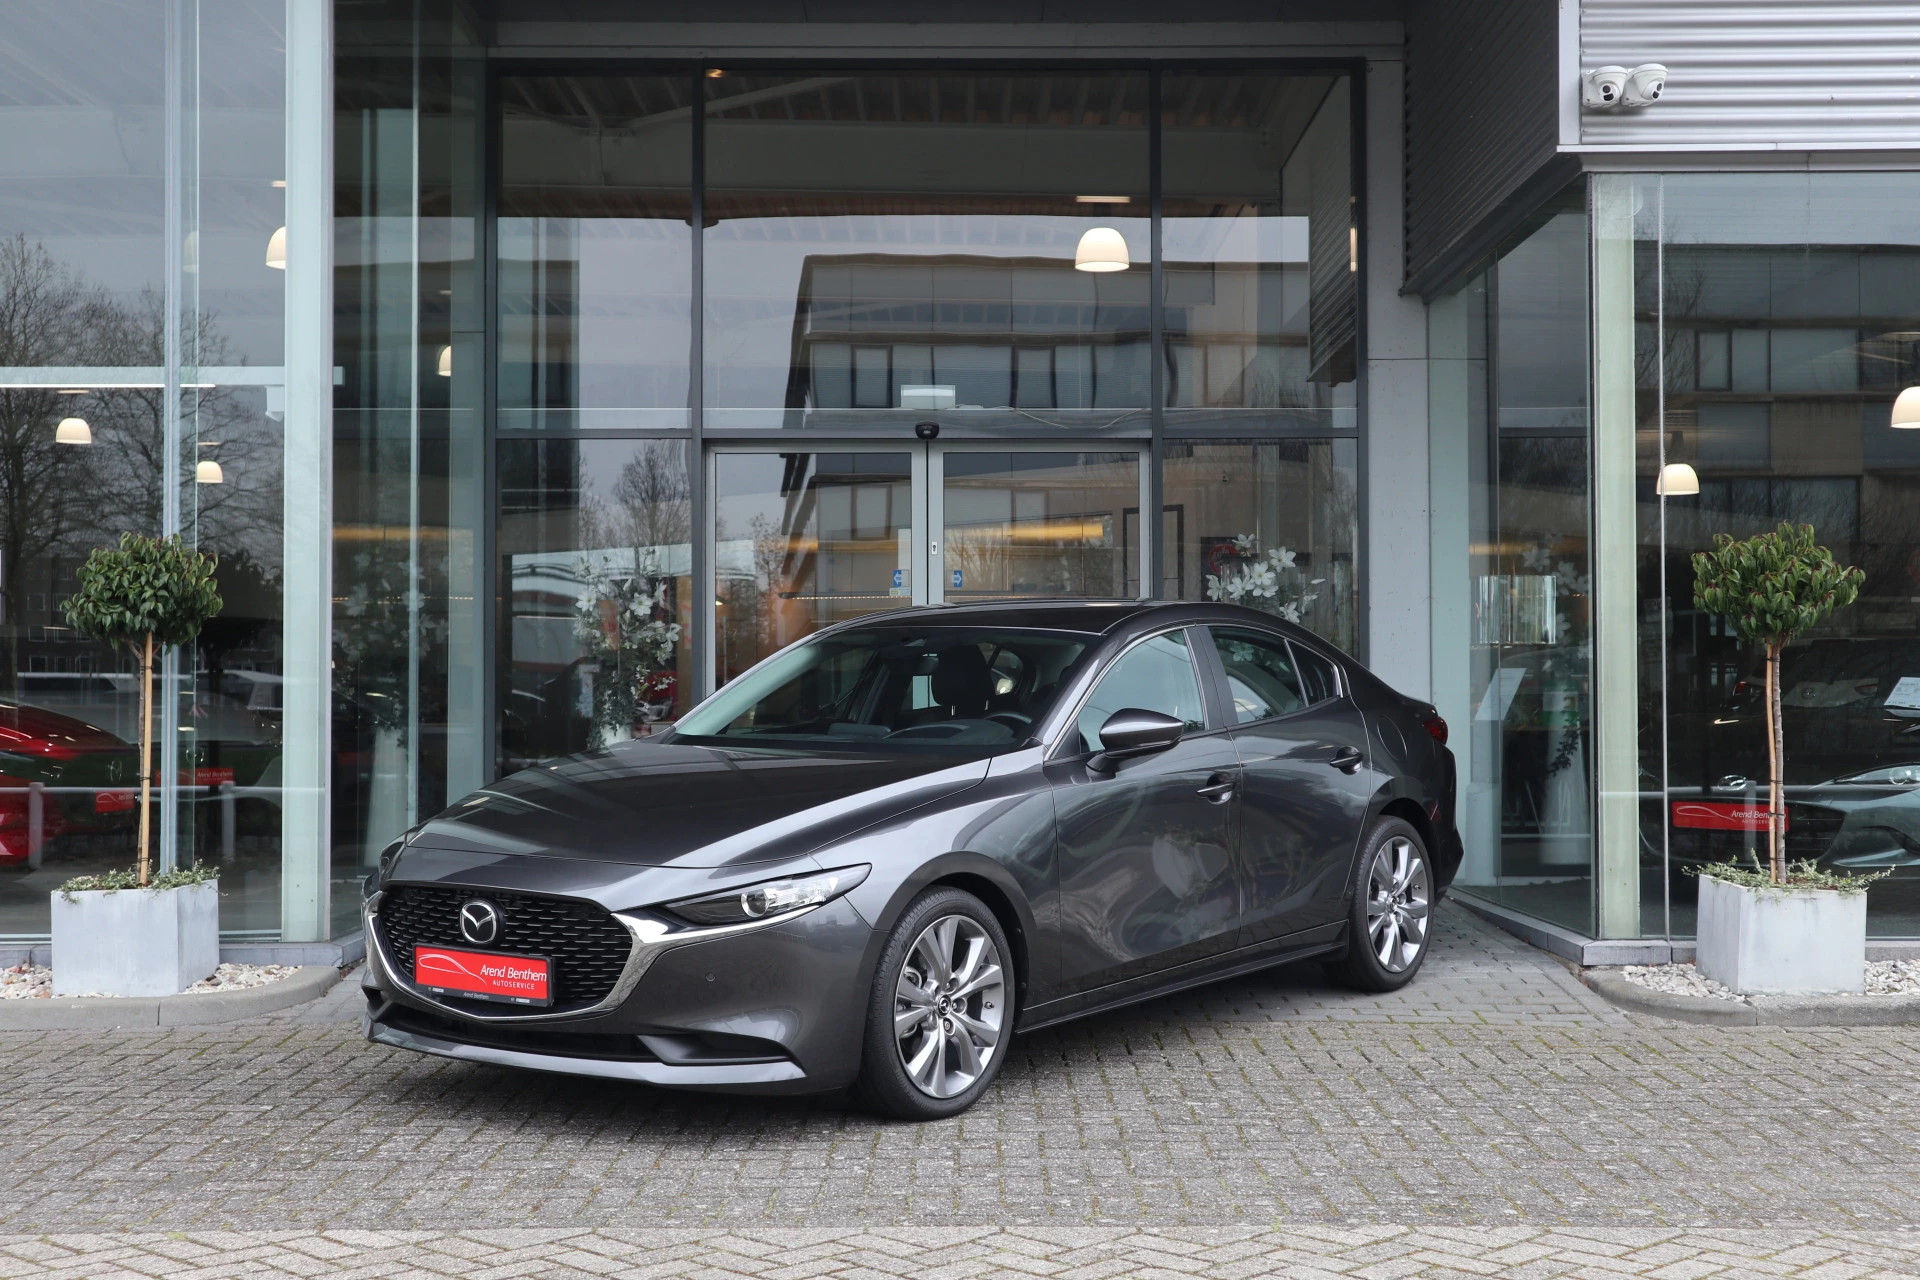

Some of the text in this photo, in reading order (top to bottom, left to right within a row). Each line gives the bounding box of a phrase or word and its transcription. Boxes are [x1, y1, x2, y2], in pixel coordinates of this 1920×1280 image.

[1731, 810, 1753, 818] Arend
[480, 964, 547, 982] Arend Benthem
[492, 979, 535, 990] AUTOSERVICE
